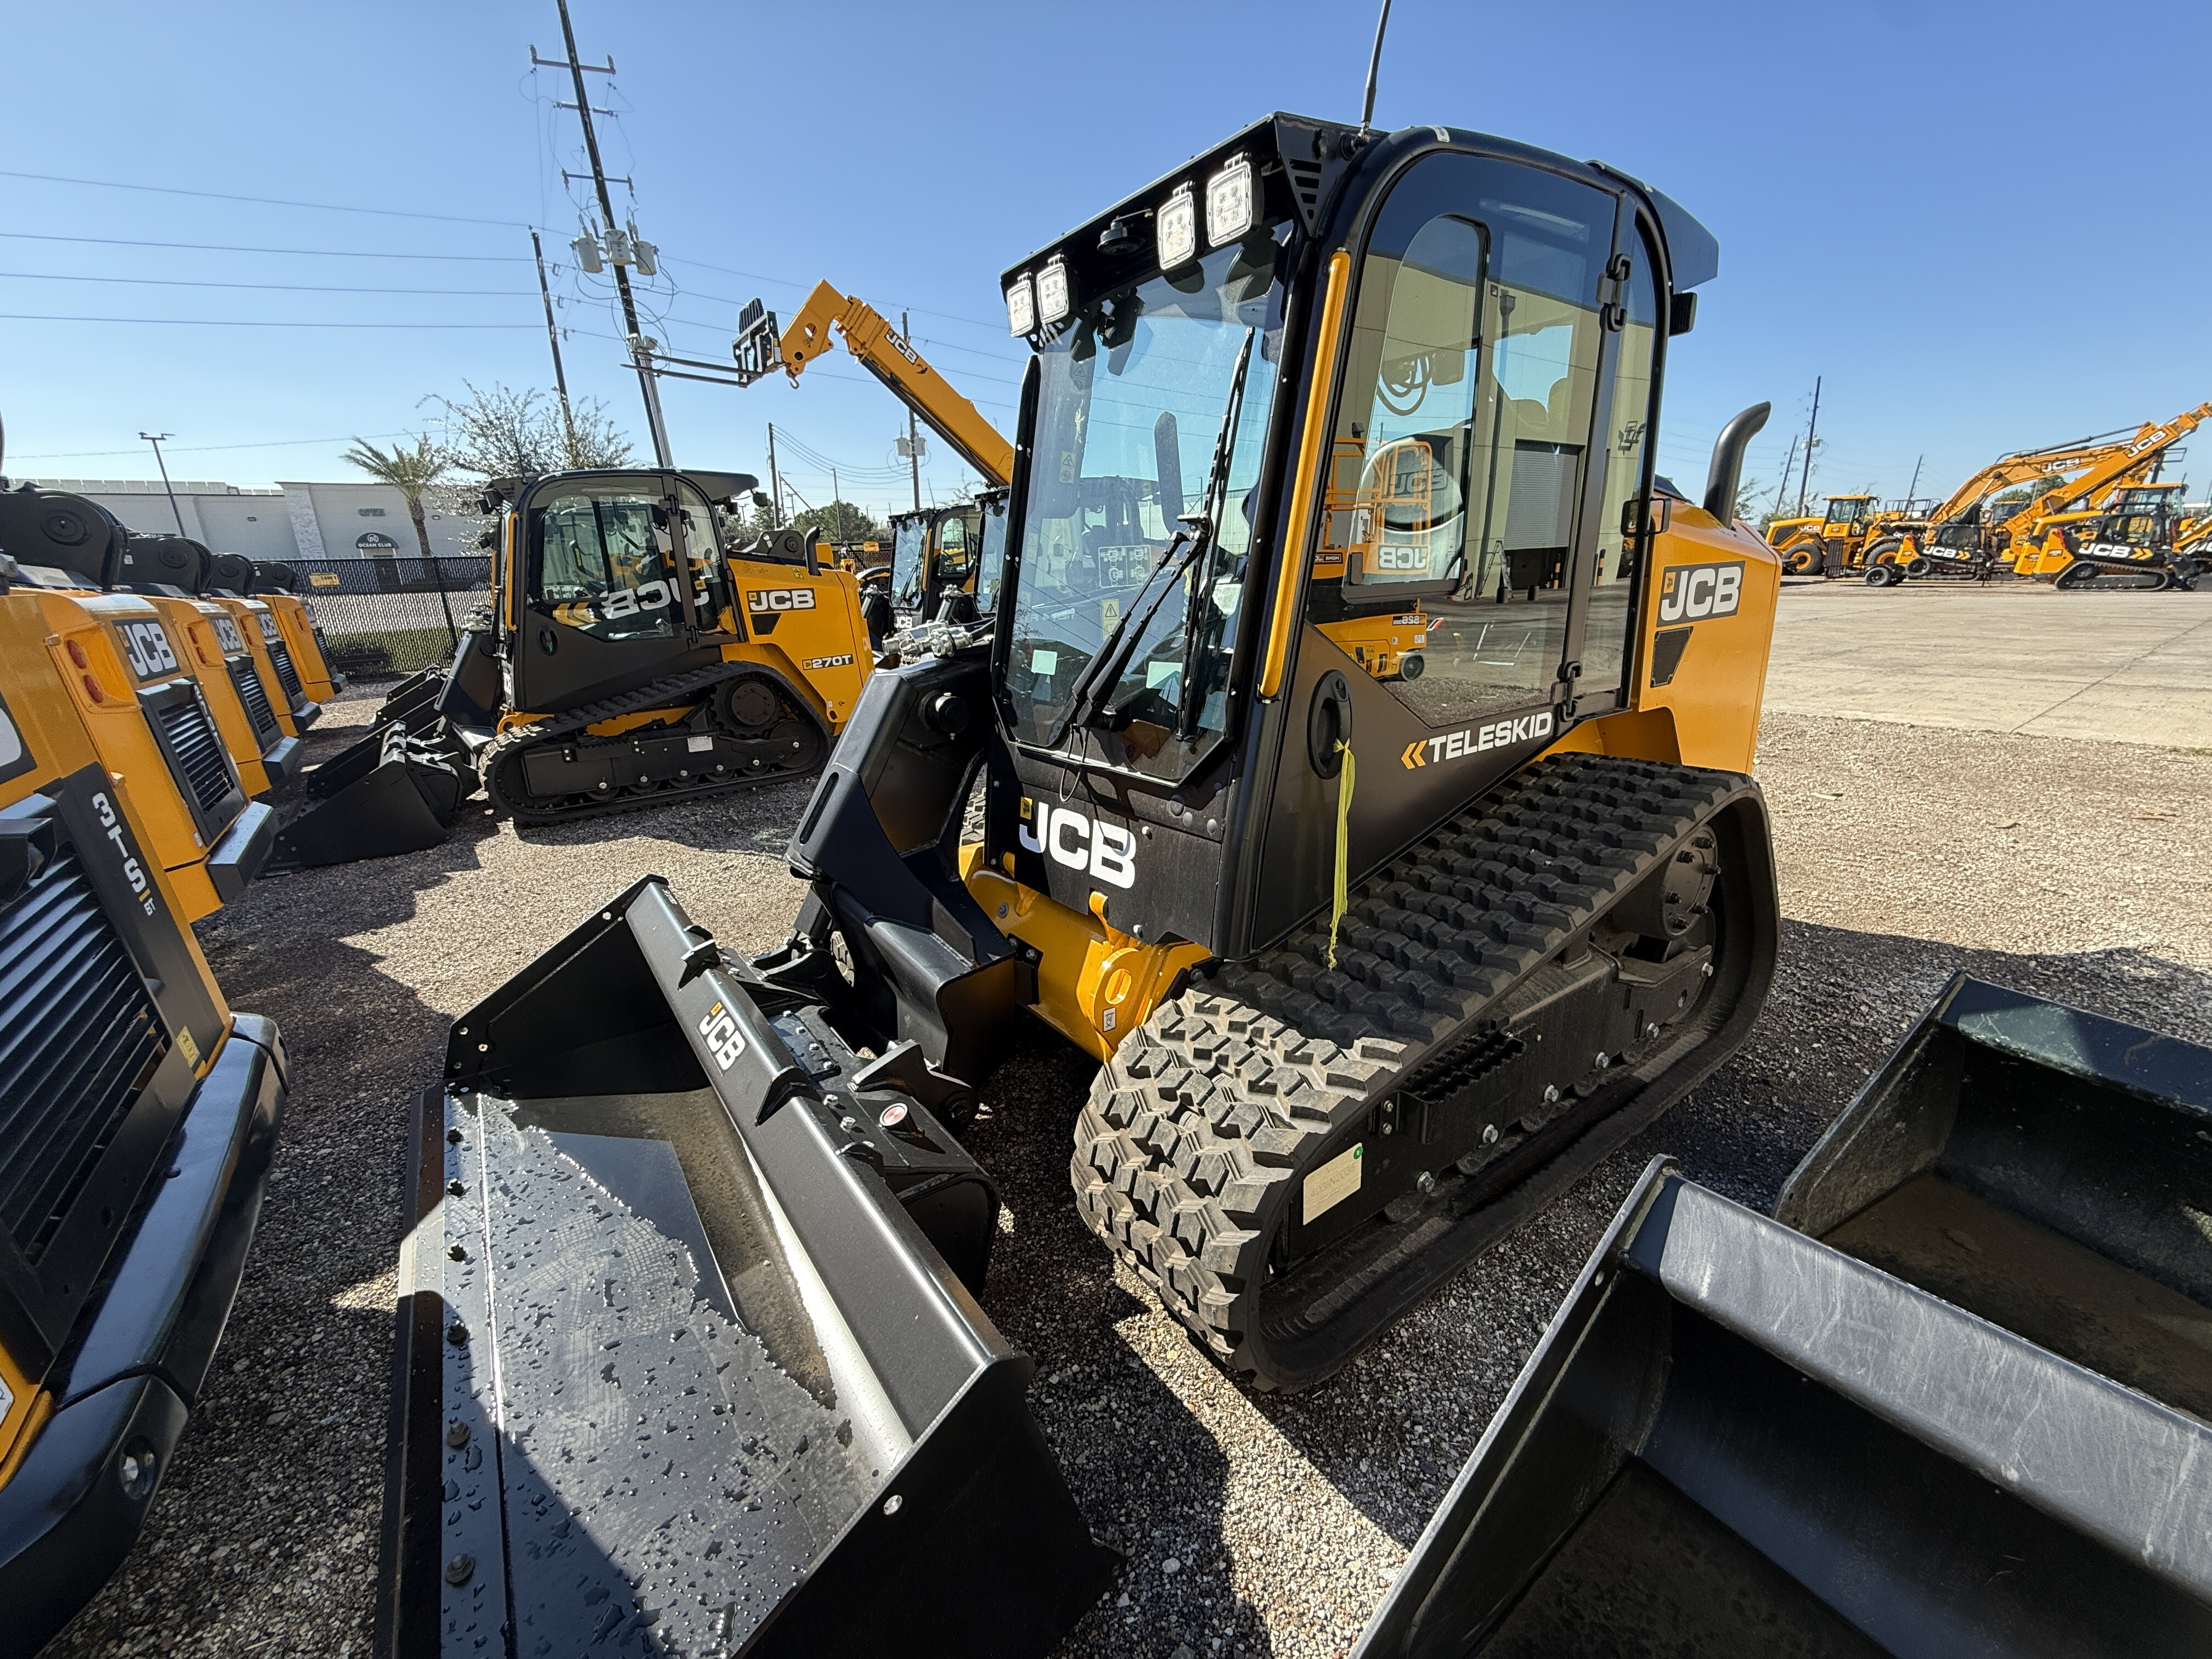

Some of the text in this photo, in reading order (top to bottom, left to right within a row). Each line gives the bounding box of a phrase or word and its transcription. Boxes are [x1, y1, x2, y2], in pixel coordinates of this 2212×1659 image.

[885, 334, 918, 364] JCB
[2127, 430, 2167, 458] JCB
[2041, 458, 2080, 473] JCB
[1923, 545, 1957, 558] JCB
[2078, 543, 2131, 558] JCB
[749, 590, 815, 611] JCB
[1661, 566, 1742, 621] JCB
[214, 619, 242, 651] JCB
[258, 613, 278, 637] JCB
[894, 616, 913, 629] JCB
[124, 623, 177, 677] JCB
[812, 654, 851, 669] 270T
[1429, 712, 1553, 763] TELESKID
[1019, 801, 1137, 889] JCB
[699, 1008, 746, 1071] JCB
